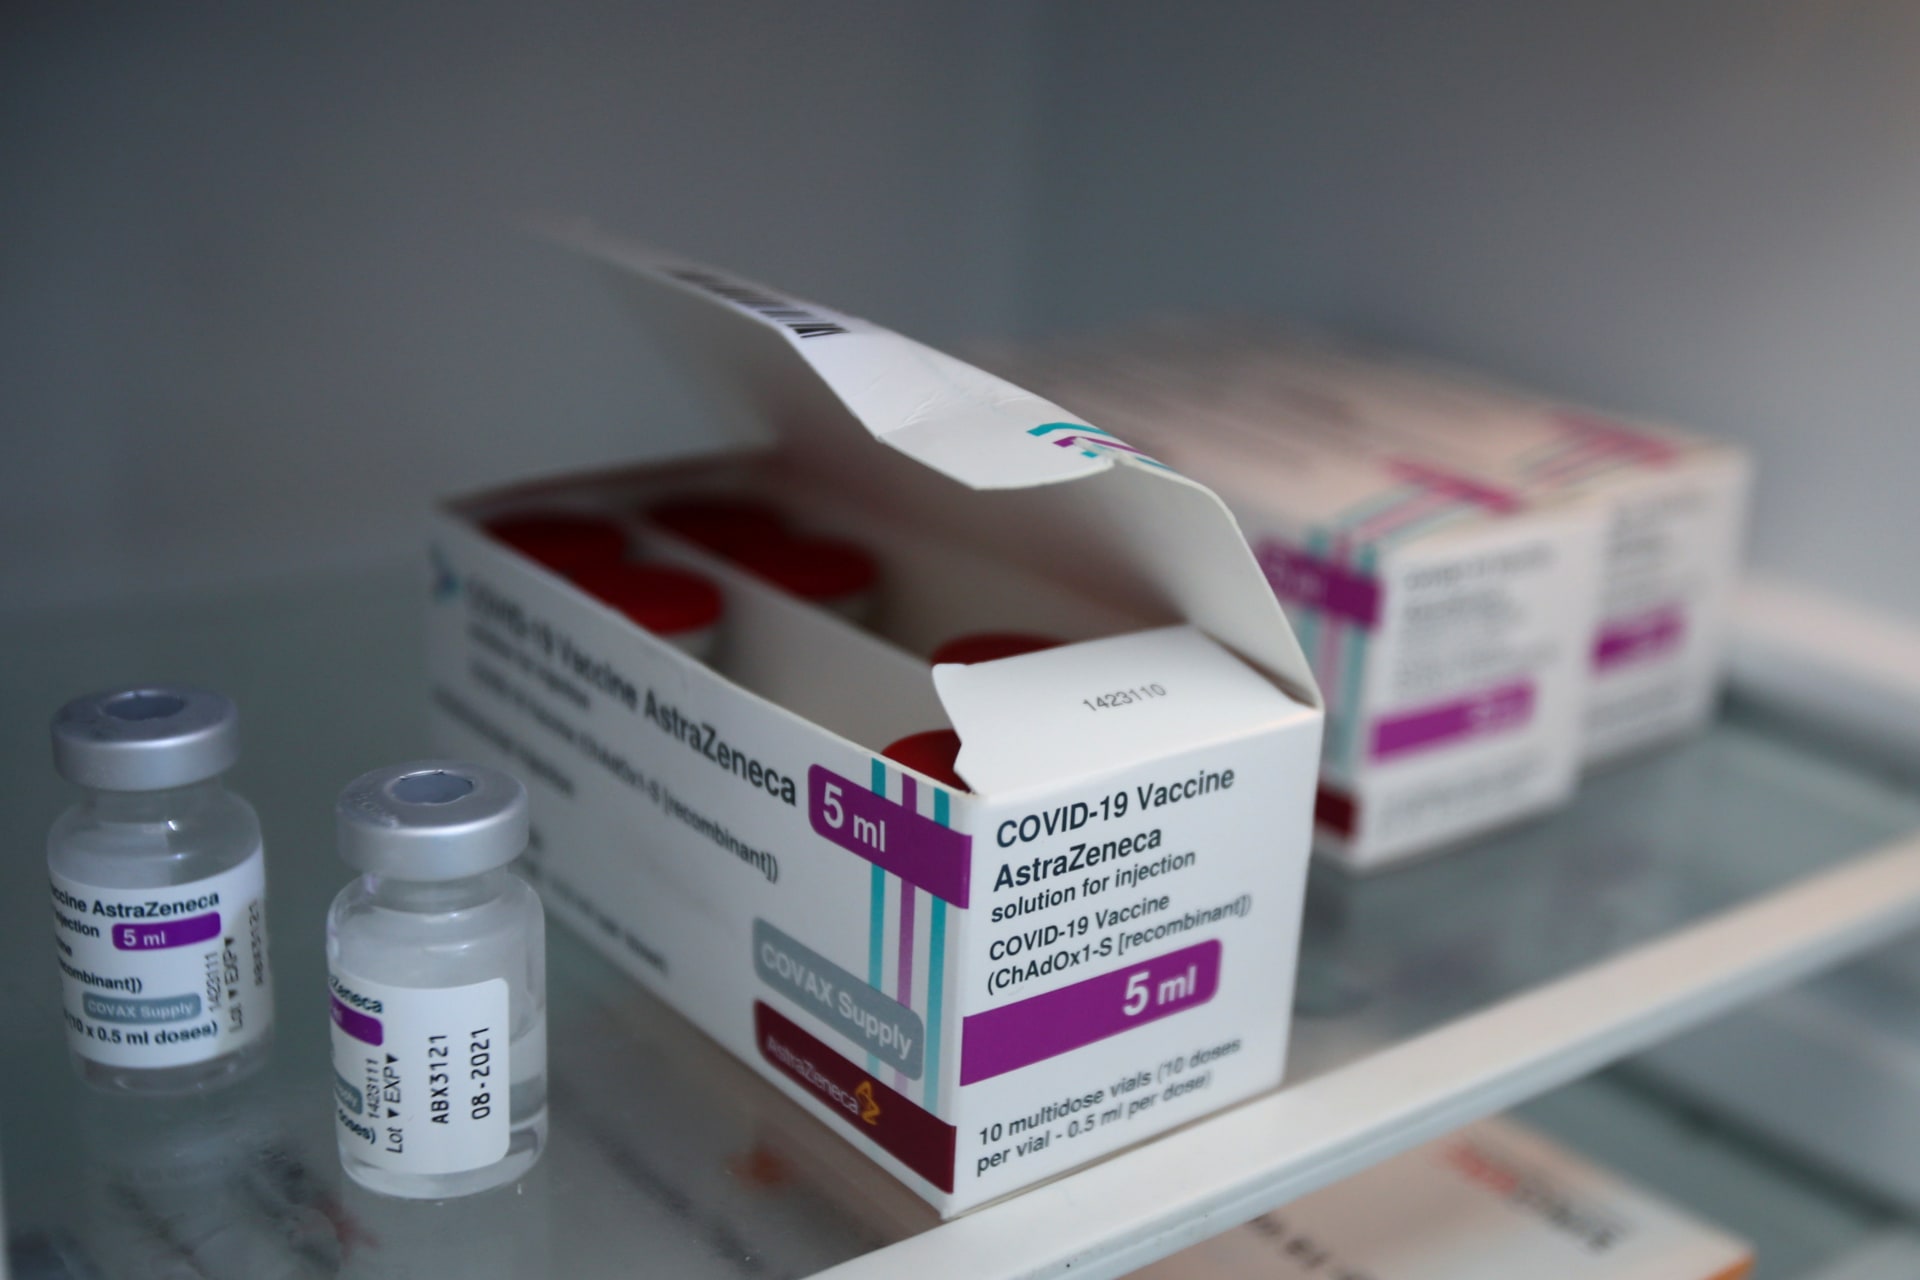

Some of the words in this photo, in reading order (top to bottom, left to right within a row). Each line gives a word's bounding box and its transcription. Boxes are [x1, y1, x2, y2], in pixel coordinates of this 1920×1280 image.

[1083, 683, 1167, 711] 1423110
[644, 687, 797, 806] AstraZeneca
[822, 782, 845, 829] 5
[853, 812, 887, 853] ml
[996, 791, 1128, 848] COVID-19
[1136, 767, 1236, 811] Vaccine
[990, 886, 1076, 923] solution
[1081, 874, 1110, 898] for
[1114, 851, 1196, 888] injection
[992, 828, 1162, 893] AstraZeneca
[92, 892, 220, 919] AstraZeneca
[123, 928, 137, 947] 5
[143, 930, 166, 946] ml
[988, 916, 1089, 962] COVID-19
[1095, 894, 1171, 930] Vaccine
[986, 936, 1113, 996] (ChAdOx1-S
[1122, 971, 1150, 1016] 5
[1157, 965, 1198, 1006] ml
[98, 1026, 122, 1044] 0.5
[126, 1031, 149, 1046] ml
[155, 1021, 218, 1046] doses)
[140, 1002, 194, 1021] Supply
[761, 942, 834, 1008] COVAX
[838, 991, 913, 1060] Supply
[383, 1066, 401, 1105] EXP
[428, 1034, 449, 1125] ABX3121
[979, 1122, 1003, 1146] 10
[1008, 1088, 1105, 1137] multidose
[1110, 1069, 1153, 1098] vials
[1189, 1037, 1243, 1070] doses
[386, 1126, 404, 1154] Lot
[976, 1148, 1011, 1178] per
[1015, 1131, 1050, 1157] vial
[1067, 1114, 1096, 1139] 0.5
[1100, 1103, 1123, 1127] ml
[1128, 1093, 1157, 1119] per
